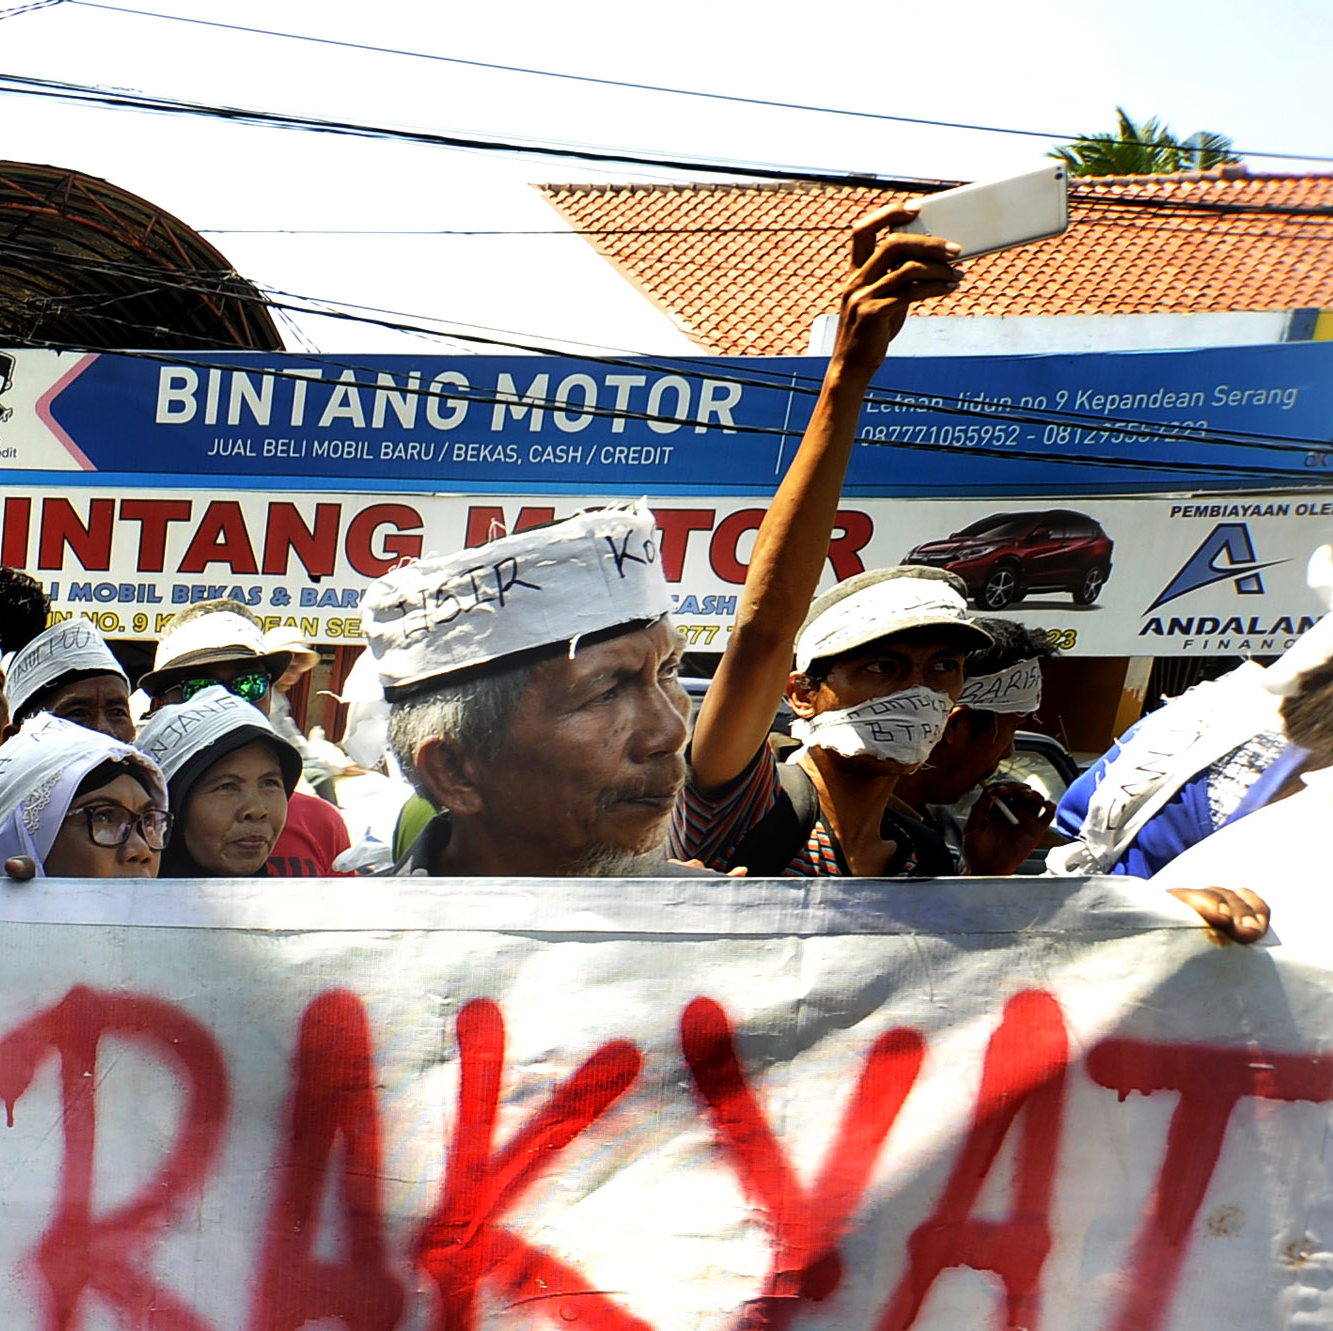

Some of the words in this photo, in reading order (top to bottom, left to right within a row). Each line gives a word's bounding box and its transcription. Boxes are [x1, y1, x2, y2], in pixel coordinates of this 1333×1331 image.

[155, 366, 471, 431] BINTANG
[491, 373, 744, 434] MOTOR
[1020, 395, 1047, 412] no
[1055, 390, 1069, 411] 9
[1075, 388, 1205, 415] Kepandean
[1212, 385, 1299, 410] Serang
[861, 424, 1021, 447] 087771055952
[207, 438, 257, 457] JUAL
[263, 438, 307, 458] BELI
[310, 440, 374, 460] MOBIL
[380, 441, 435, 461] BARU
[452, 443, 524, 467] BEKAS,
[528, 445, 583, 466] CASH
[600, 446, 674, 466] CREDIT
[1170, 503, 1290, 518] PEMBIAYAAN
[68, 582, 163, 604] MOBIL
[171, 583, 263, 606] BEKAS
[269, 587, 291, 607] &
[133, 613, 149, 633] 9
[1183, 638, 1296, 650] FINANC
